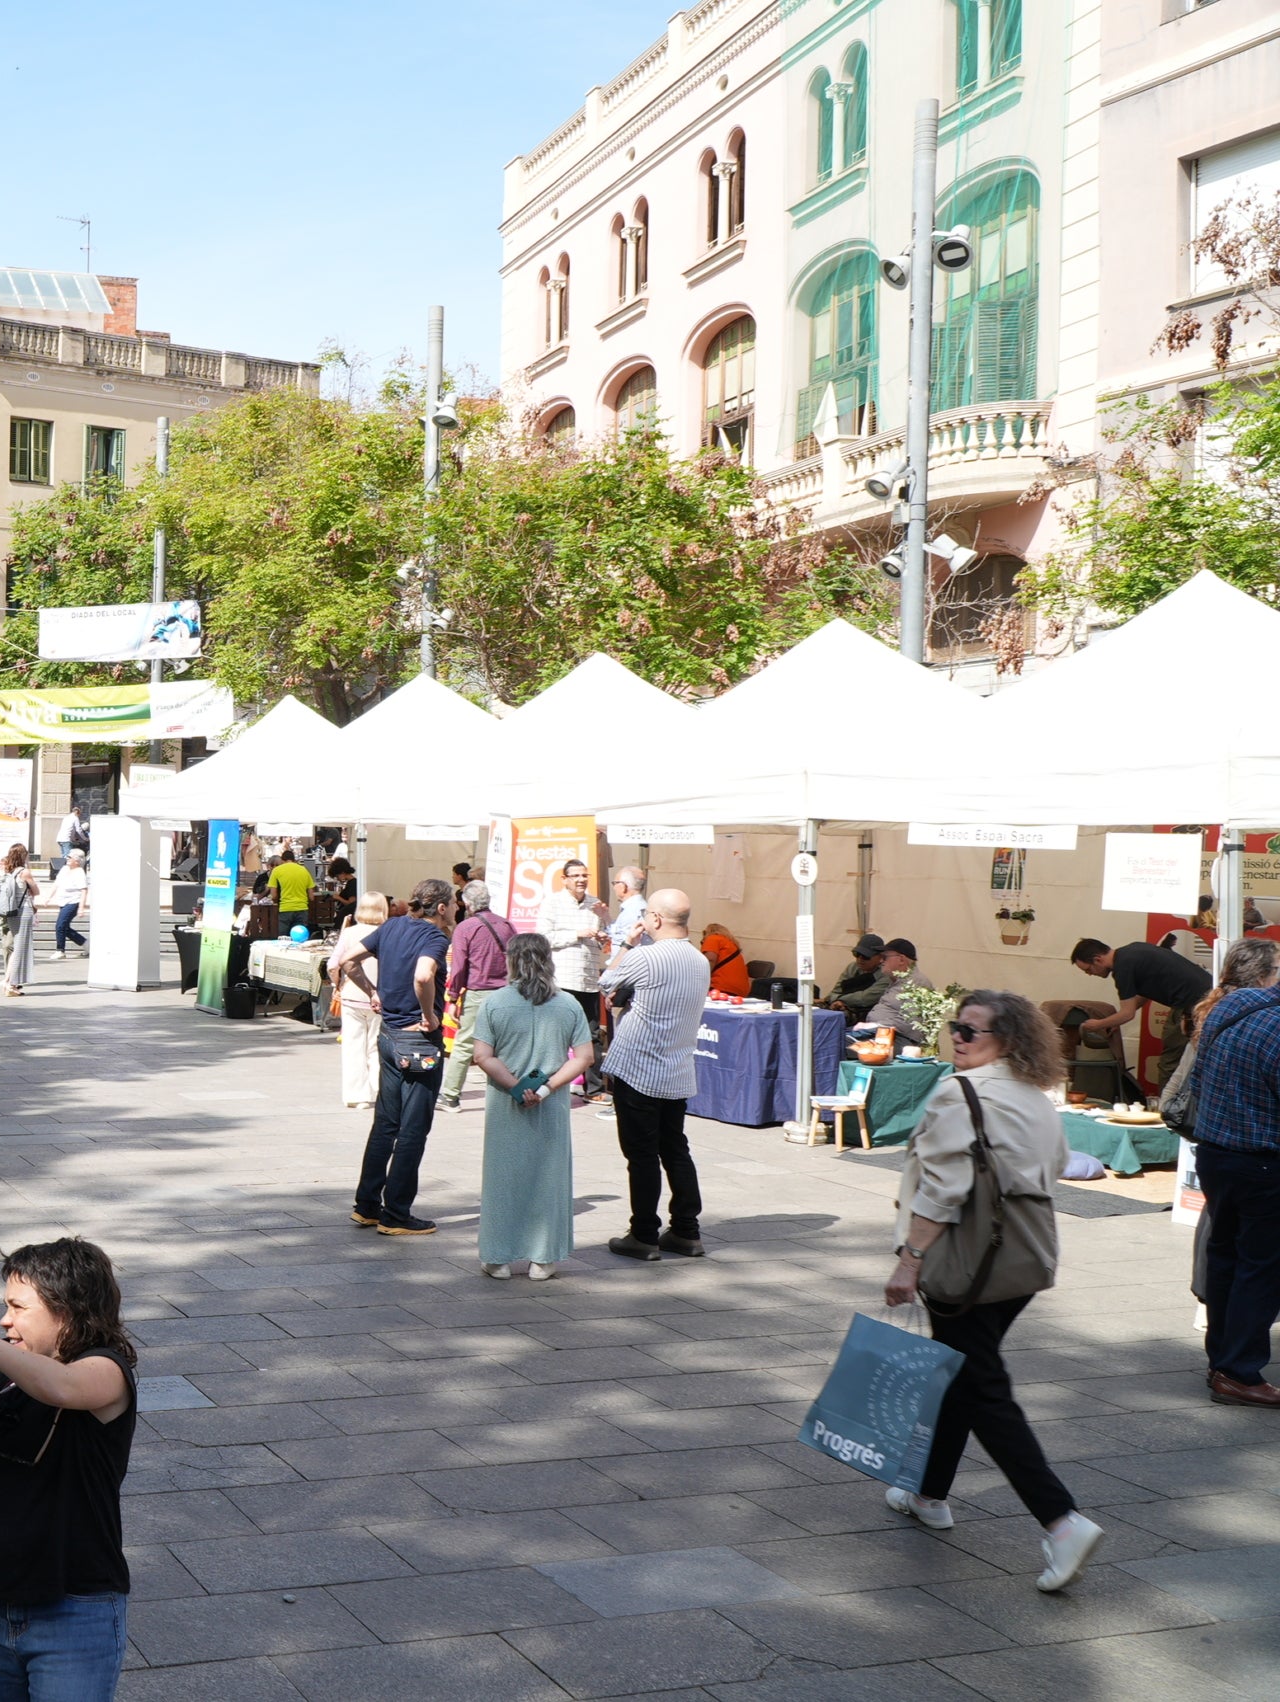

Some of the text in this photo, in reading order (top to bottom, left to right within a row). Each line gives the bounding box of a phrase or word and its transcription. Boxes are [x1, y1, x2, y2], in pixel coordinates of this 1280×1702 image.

[71, 611, 93, 619] DIADA
[96, 610, 110, 618] DEL
[975, 829, 1008, 843] Espai
[1011, 830, 1044, 843] Sacra
[516, 845, 535, 860] No
[812, 1419, 886, 1471] Progrés
